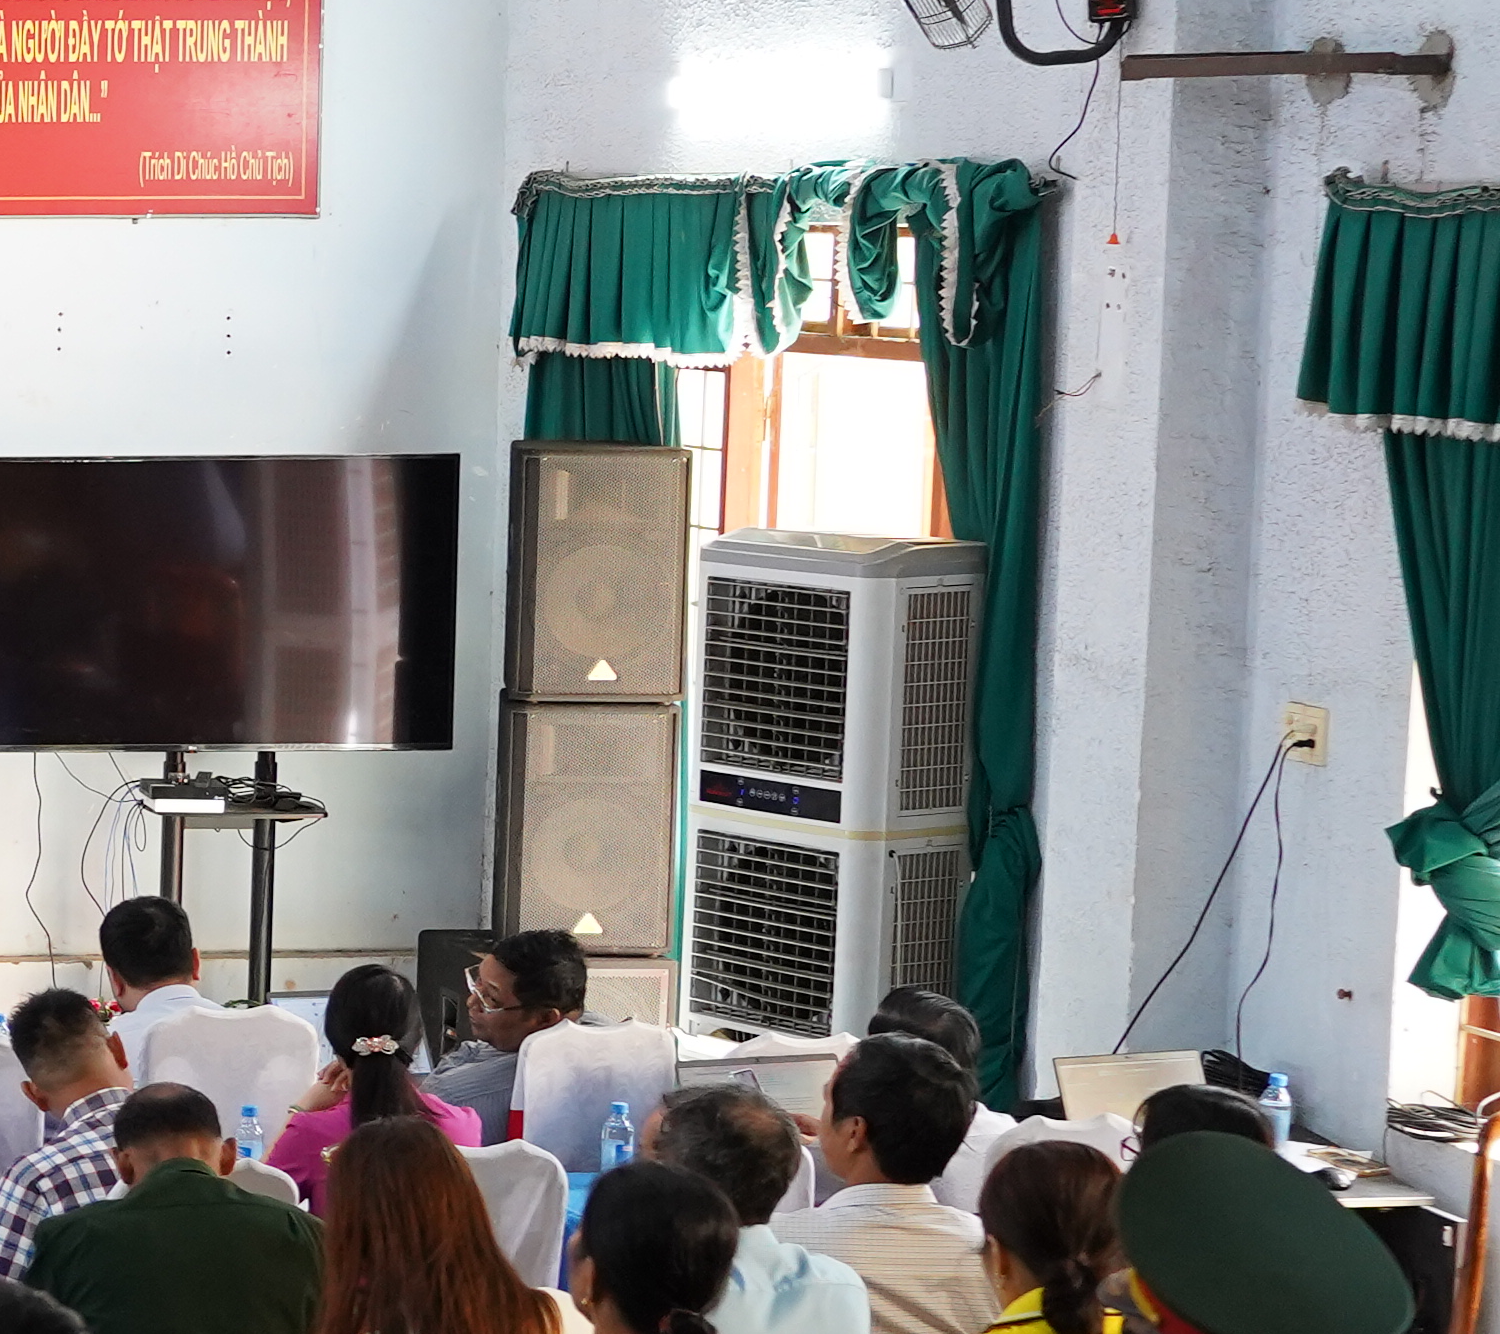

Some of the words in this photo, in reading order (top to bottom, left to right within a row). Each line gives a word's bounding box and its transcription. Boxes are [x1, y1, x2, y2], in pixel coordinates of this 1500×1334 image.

[19, 71, 57, 122] NHÂN
[139, 151, 171, 187] (Trích
[175, 152, 186, 179] Di
[189, 151, 218, 179] Chúc
[221, 146, 237, 179] Hồ
[240, 151, 263, 179] Chủ
[265, 151, 293, 187] Tịch)
